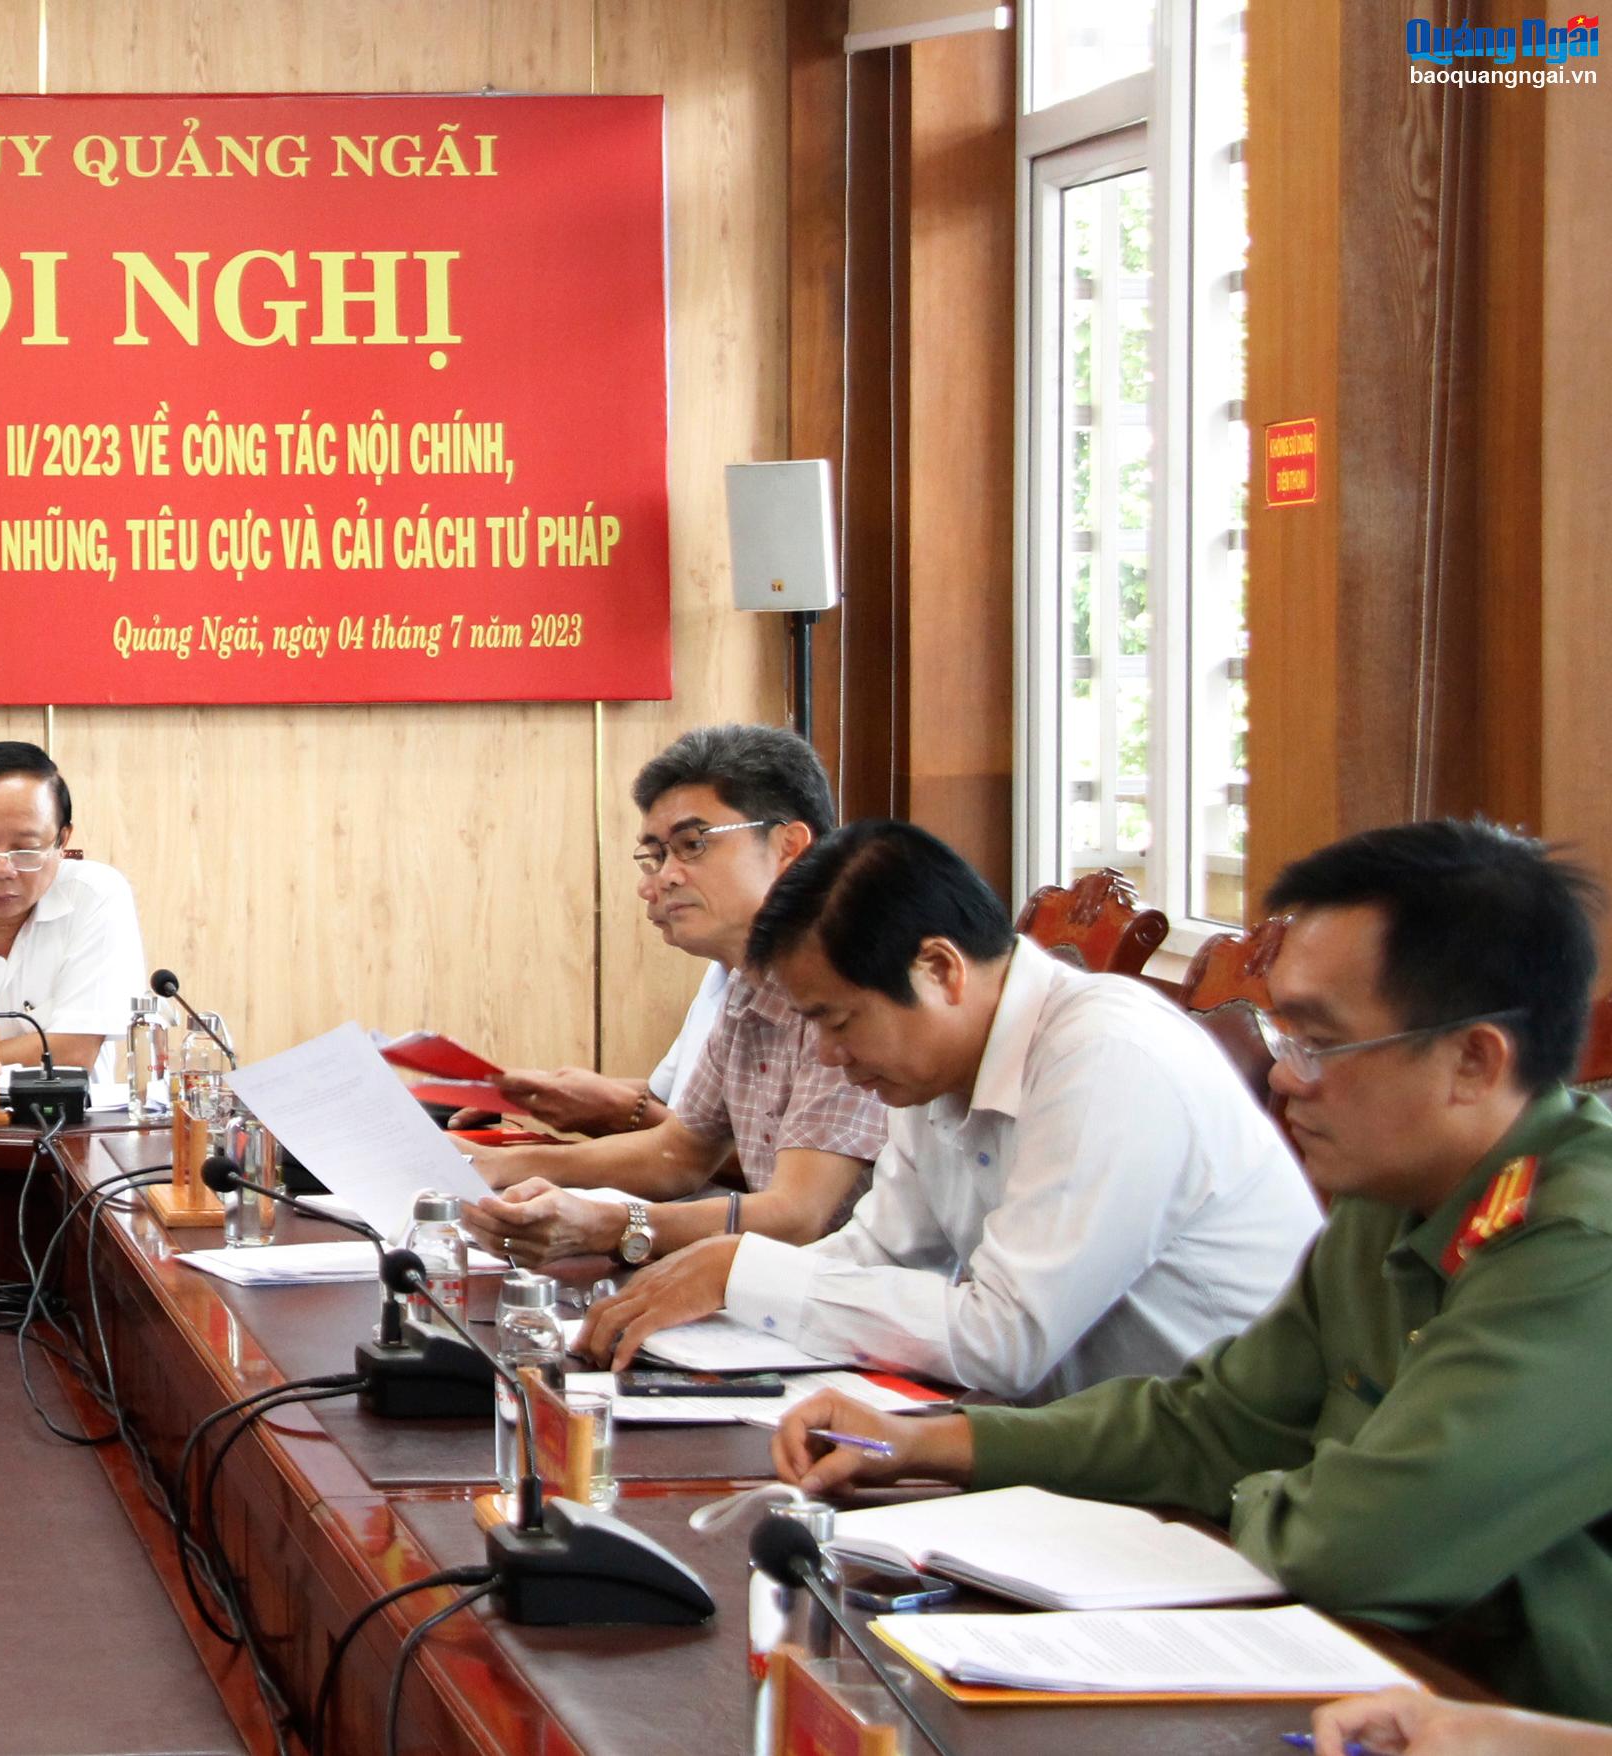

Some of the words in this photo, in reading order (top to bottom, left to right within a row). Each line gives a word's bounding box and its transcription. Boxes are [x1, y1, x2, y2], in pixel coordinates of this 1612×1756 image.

[73, 117, 311, 187] QUẢNG
[331, 124, 498, 178] NGÃI
[113, 249, 462, 370] NGHỊ
[7, 424, 121, 477] II/2023
[130, 401, 170, 475] VỀ
[182, 410, 267, 476] CÔNG
[275, 409, 337, 475] TÁC
[348, 409, 399, 485] NỘI
[410, 410, 514, 484] CHÍNH,
[1, 506, 117, 582] NHŨNG,
[126, 505, 198, 572] TIÊU
[209, 515, 271, 582] CỰC
[280, 504, 321, 570] VÀ
[332, 497, 383, 570] CẢI
[394, 503, 476, 570] CÁCH
[486, 507, 529, 569] TƯ
[538, 502, 620, 568] PHÁP
[113, 614, 193, 660] Quảng
[199, 616, 264, 660] Ngãi,
[273, 617, 330, 659] ngày
[338, 616, 365, 650] 04
[372, 614, 442, 658] tháng
[450, 615, 464, 648] 7
[470, 617, 522, 648] năm
[530, 614, 583, 648] 2023
